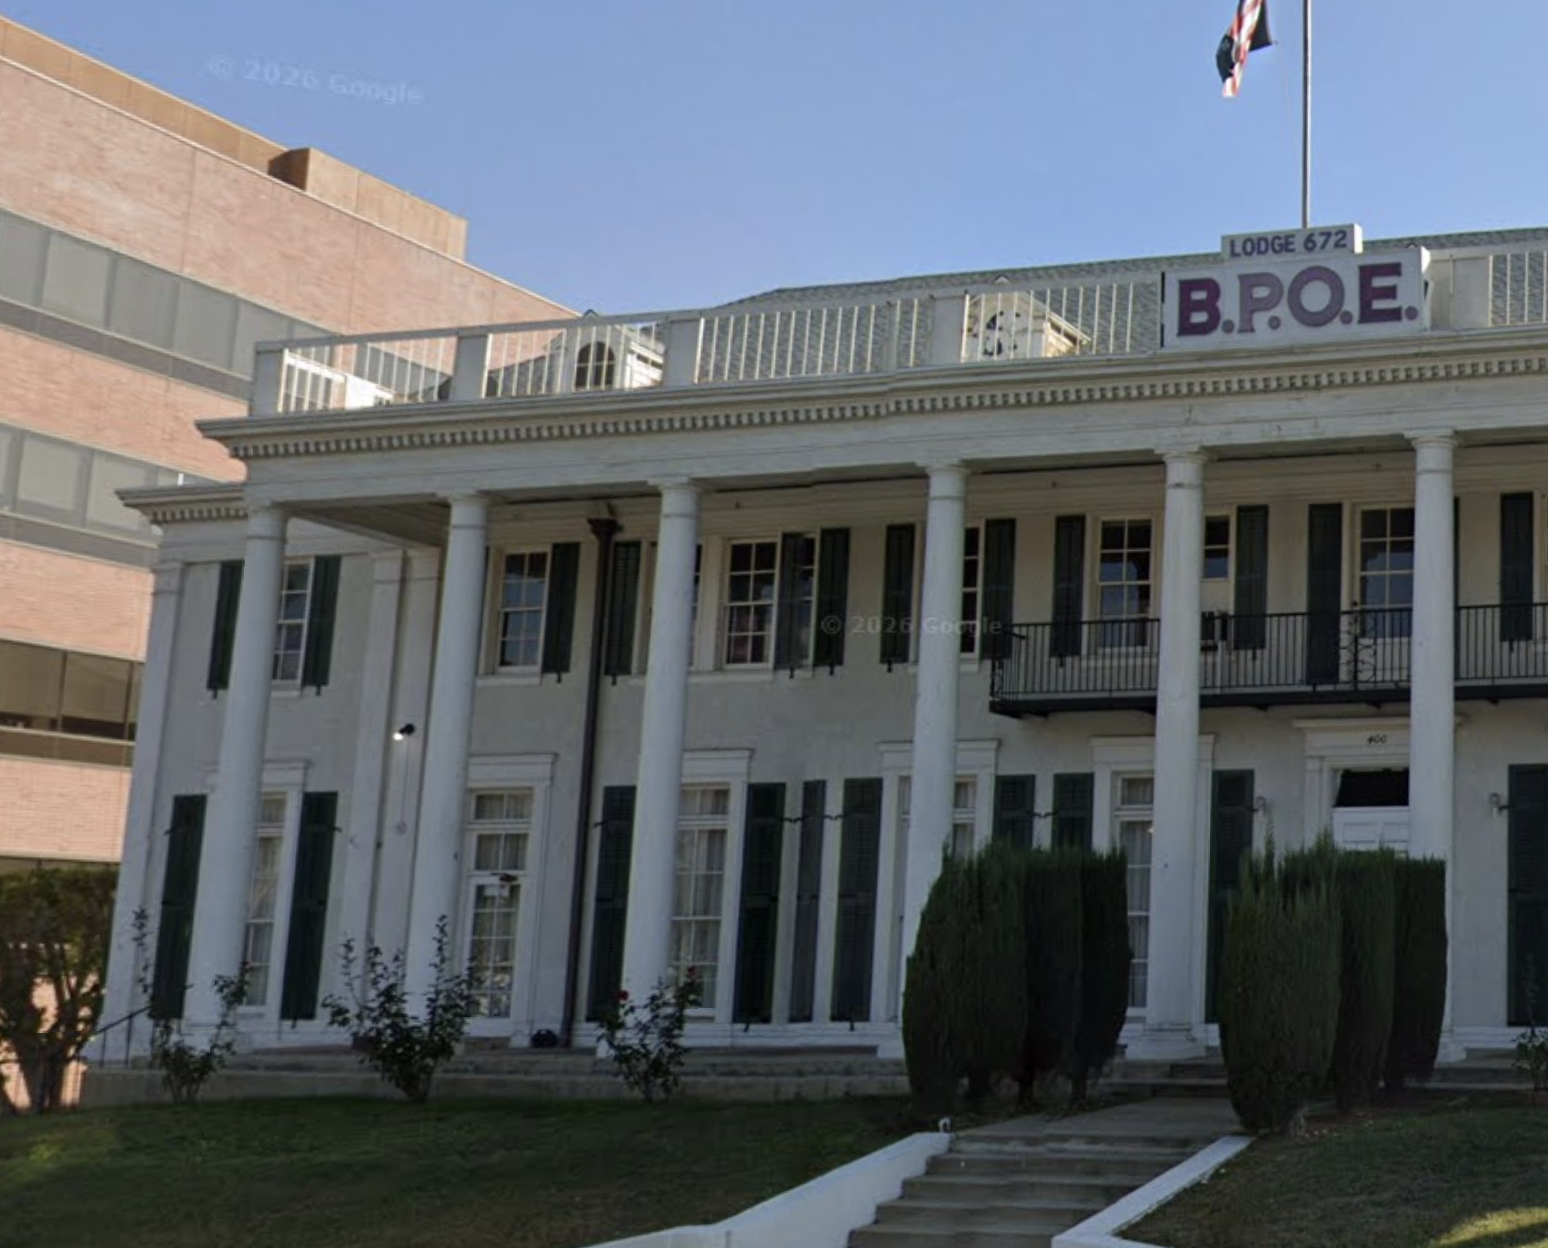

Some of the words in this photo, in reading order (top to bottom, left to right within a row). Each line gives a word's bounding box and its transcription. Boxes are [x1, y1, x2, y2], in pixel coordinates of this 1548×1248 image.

[1229, 233, 1296, 258] LODGE
[1303, 229, 1348, 252] 672
[1176, 261, 1419, 338] B.P.O.E.
